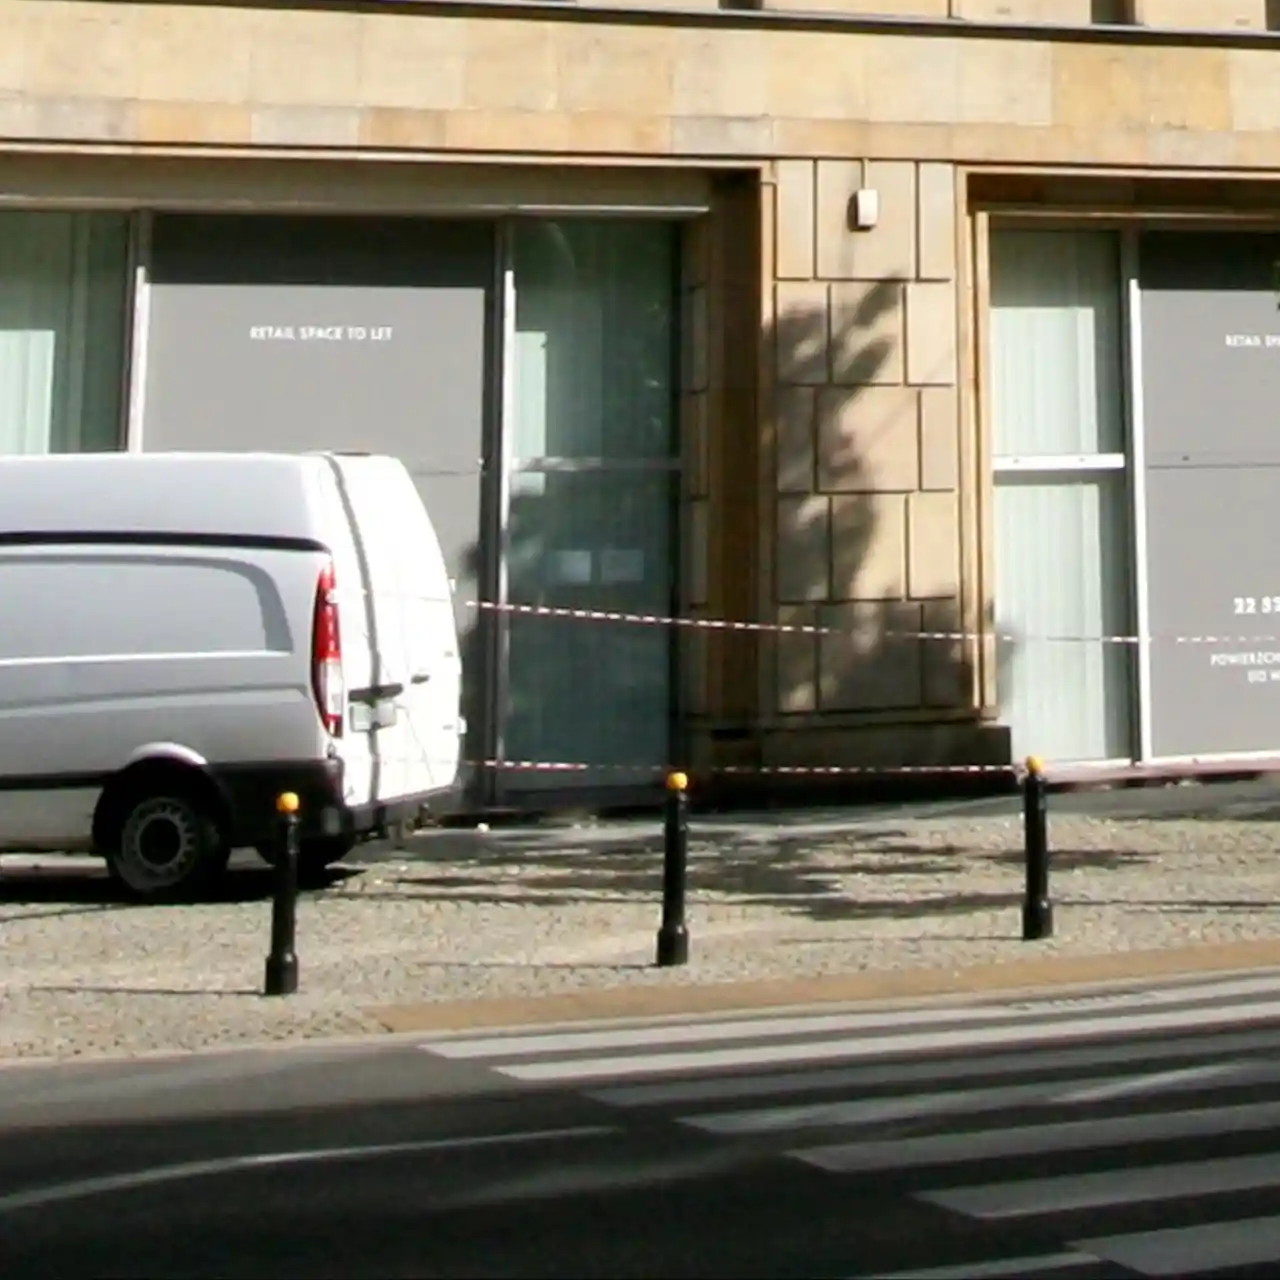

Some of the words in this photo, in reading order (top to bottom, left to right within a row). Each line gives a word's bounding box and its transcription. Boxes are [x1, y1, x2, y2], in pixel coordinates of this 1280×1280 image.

[249, 325, 295, 341] RETAIL
[299, 325, 343, 341] SPACE
[347, 325, 367, 341] TO
[370, 325, 393, 341] LET
[1233, 597, 1257, 614] 22
